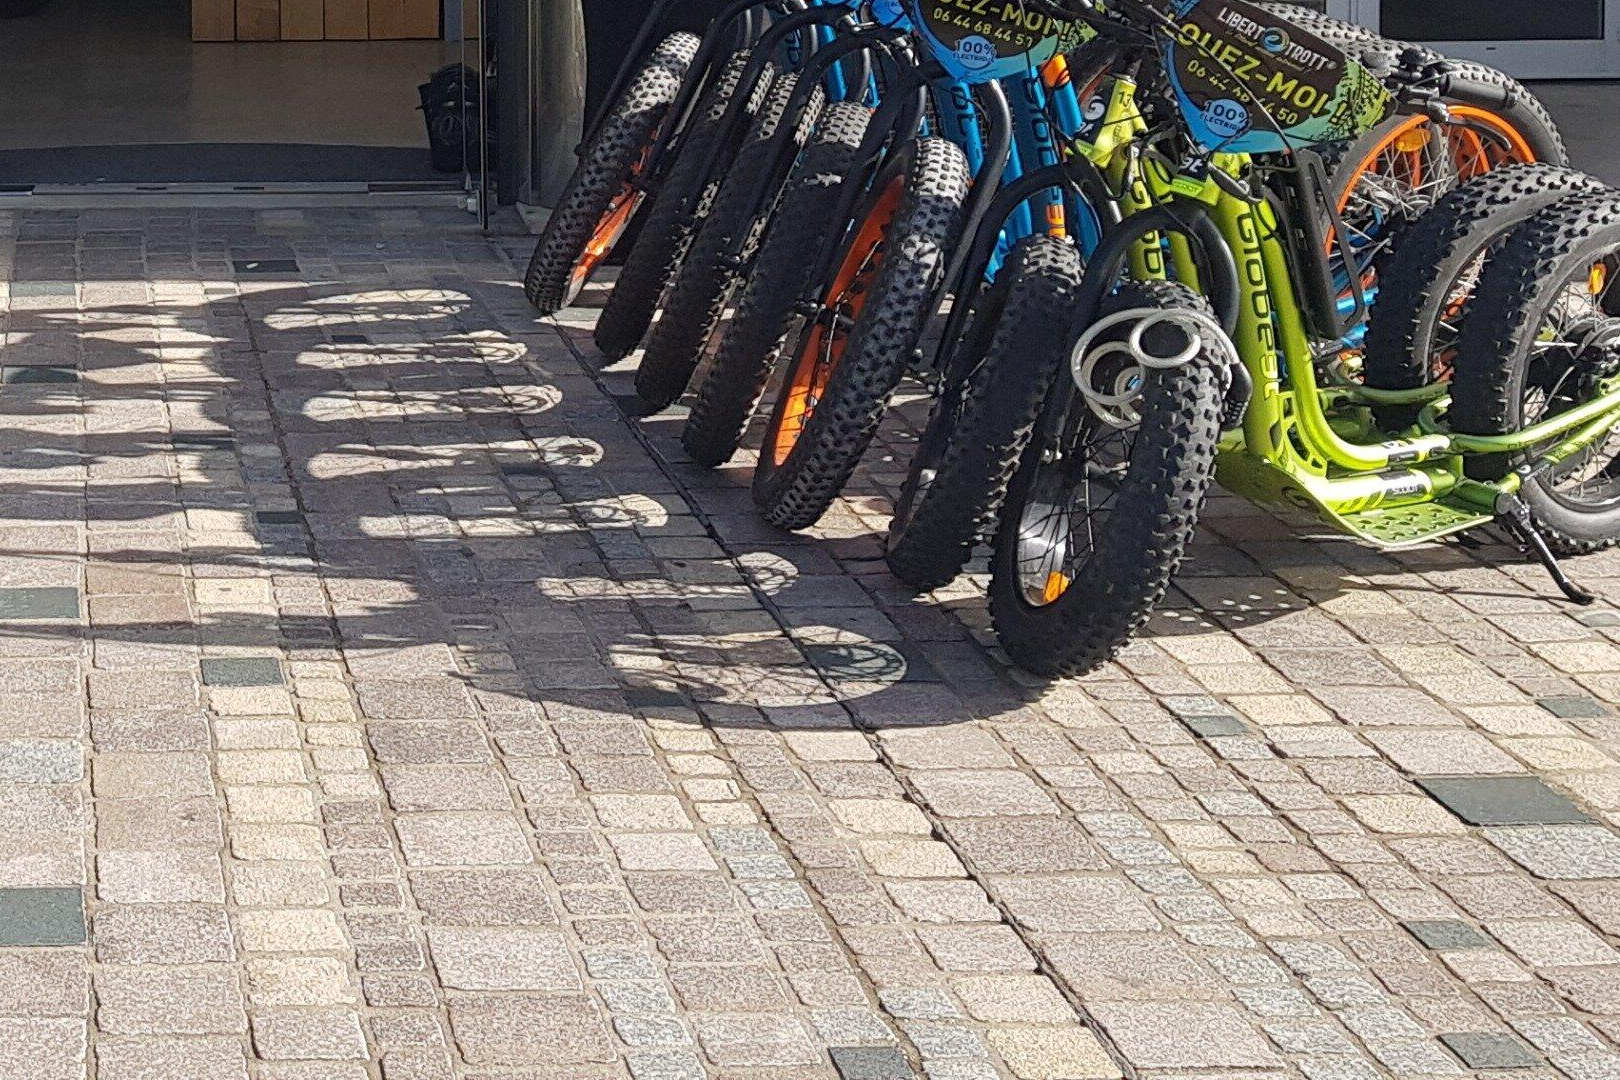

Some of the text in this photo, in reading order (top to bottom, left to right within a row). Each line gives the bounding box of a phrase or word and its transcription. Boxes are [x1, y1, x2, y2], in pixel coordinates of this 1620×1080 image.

[933, 6, 951, 23] 06
[953, 14, 972, 30] 44
[973, 20, 992, 36] 68
[994, 27, 1013, 42] 44
[1216, 7, 1265, 40] LIBERT
[1283, 40, 1328, 71] TROTT
[1186, 59, 1206, 77] 06
[1277, 109, 1298, 125] 50
